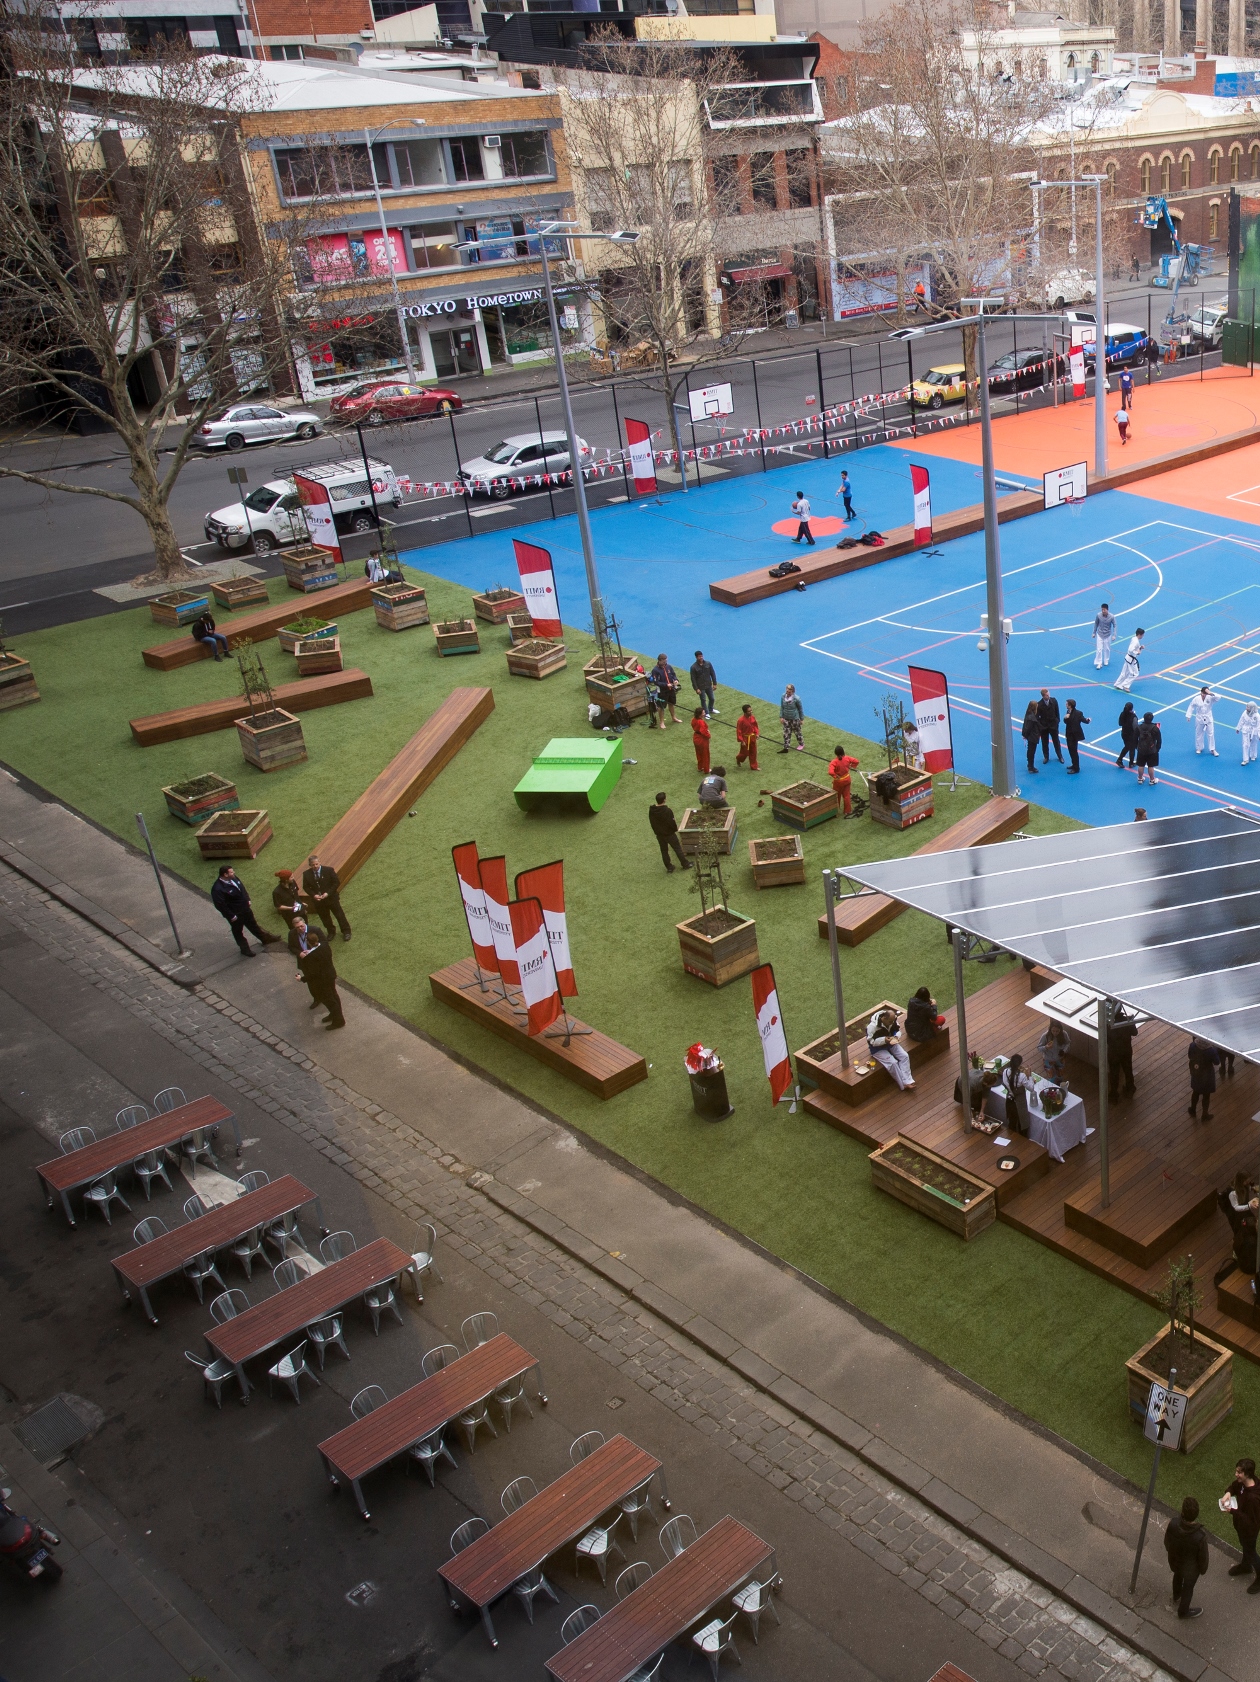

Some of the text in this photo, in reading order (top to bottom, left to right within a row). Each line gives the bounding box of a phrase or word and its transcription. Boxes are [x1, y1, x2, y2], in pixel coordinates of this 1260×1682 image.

[373, 236, 395, 245] OPN
[402, 300, 456, 319] TOKYO
[1157, 1391, 1180, 1408] ONE
[1153, 1401, 1179, 1419] WAY
